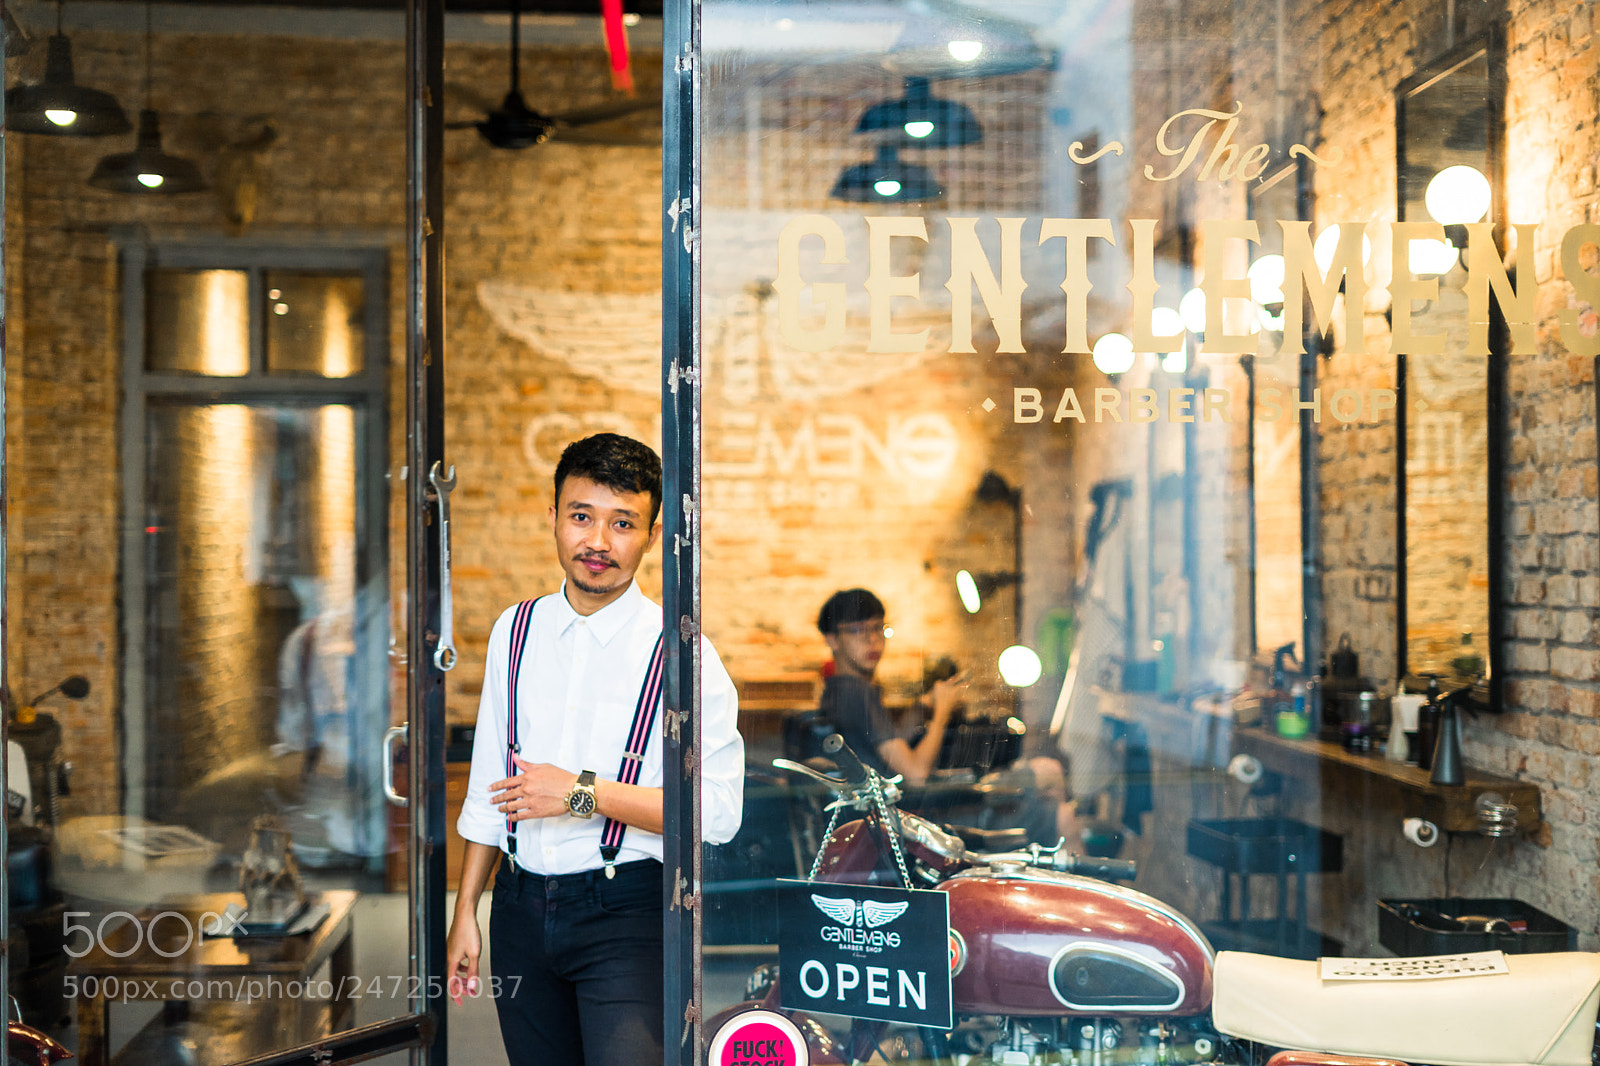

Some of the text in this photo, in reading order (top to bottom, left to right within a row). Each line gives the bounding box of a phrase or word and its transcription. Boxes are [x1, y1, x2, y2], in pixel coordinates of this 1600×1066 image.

[1144, 101, 1270, 182] The
[1013, 387, 1397, 424] BARBER SHOP
[820, 926, 901, 948] GENTLEMENS
[838, 943, 883, 954] BARBER SHOP
[799, 959, 927, 1010] OPEN
[733, 1040, 784, 1059] FUCK!
